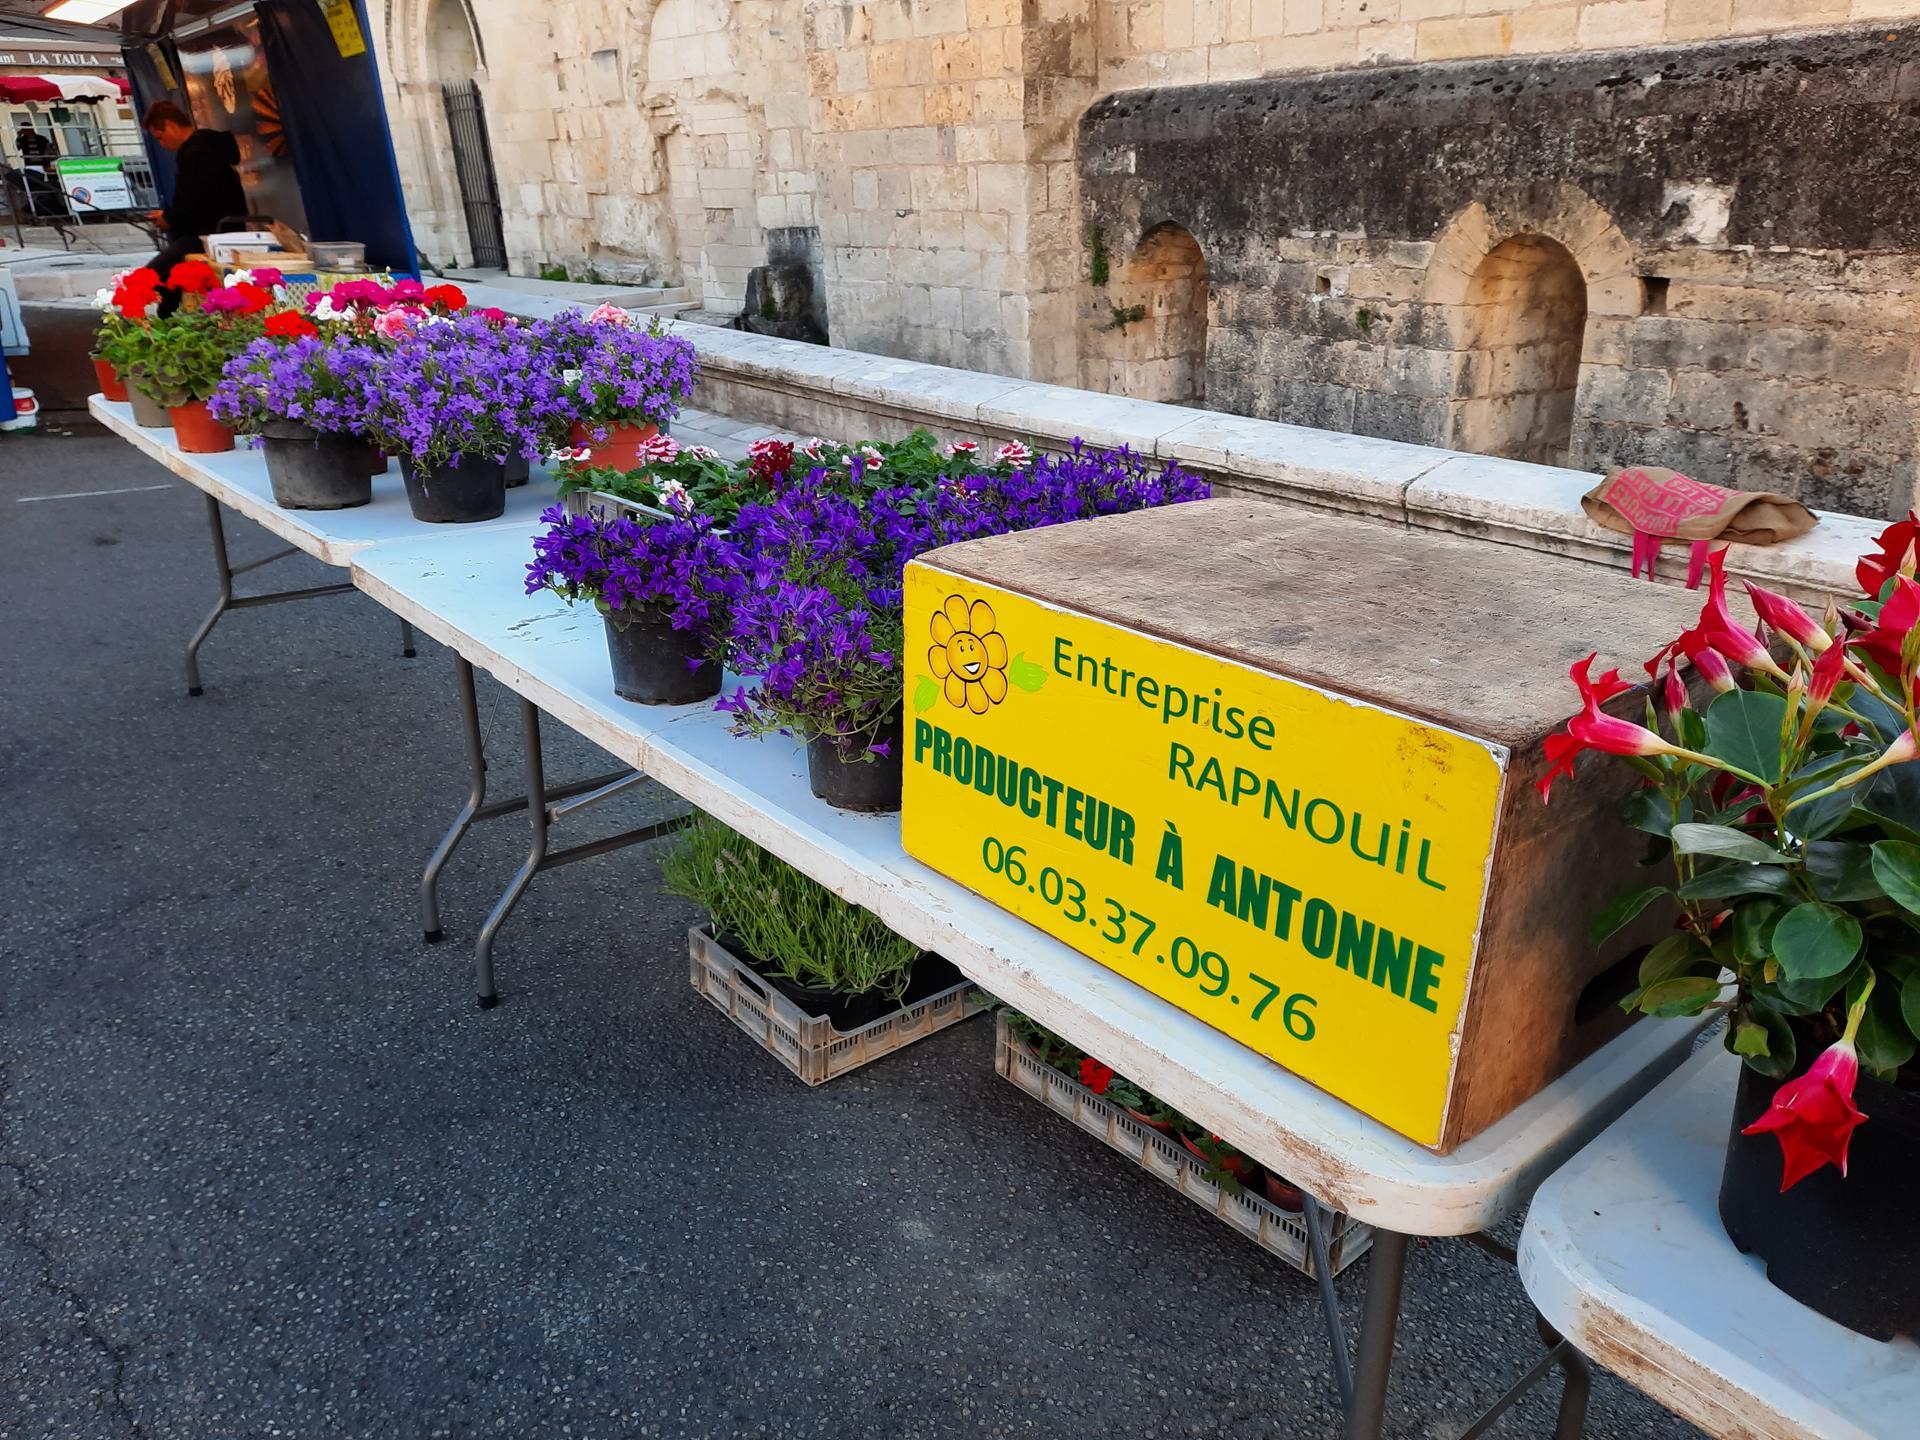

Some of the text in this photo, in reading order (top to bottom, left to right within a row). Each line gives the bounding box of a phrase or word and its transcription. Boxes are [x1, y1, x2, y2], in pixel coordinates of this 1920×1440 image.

[28, 52, 49, 65] LA
[52, 53, 99, 66] TAULA
[1054, 636, 1276, 751] Entreprise
[914, 718, 1446, 1014] PRODUCTEUR À ANTONNE
[982, 836, 1318, 1042] 06.03.37.09.76
